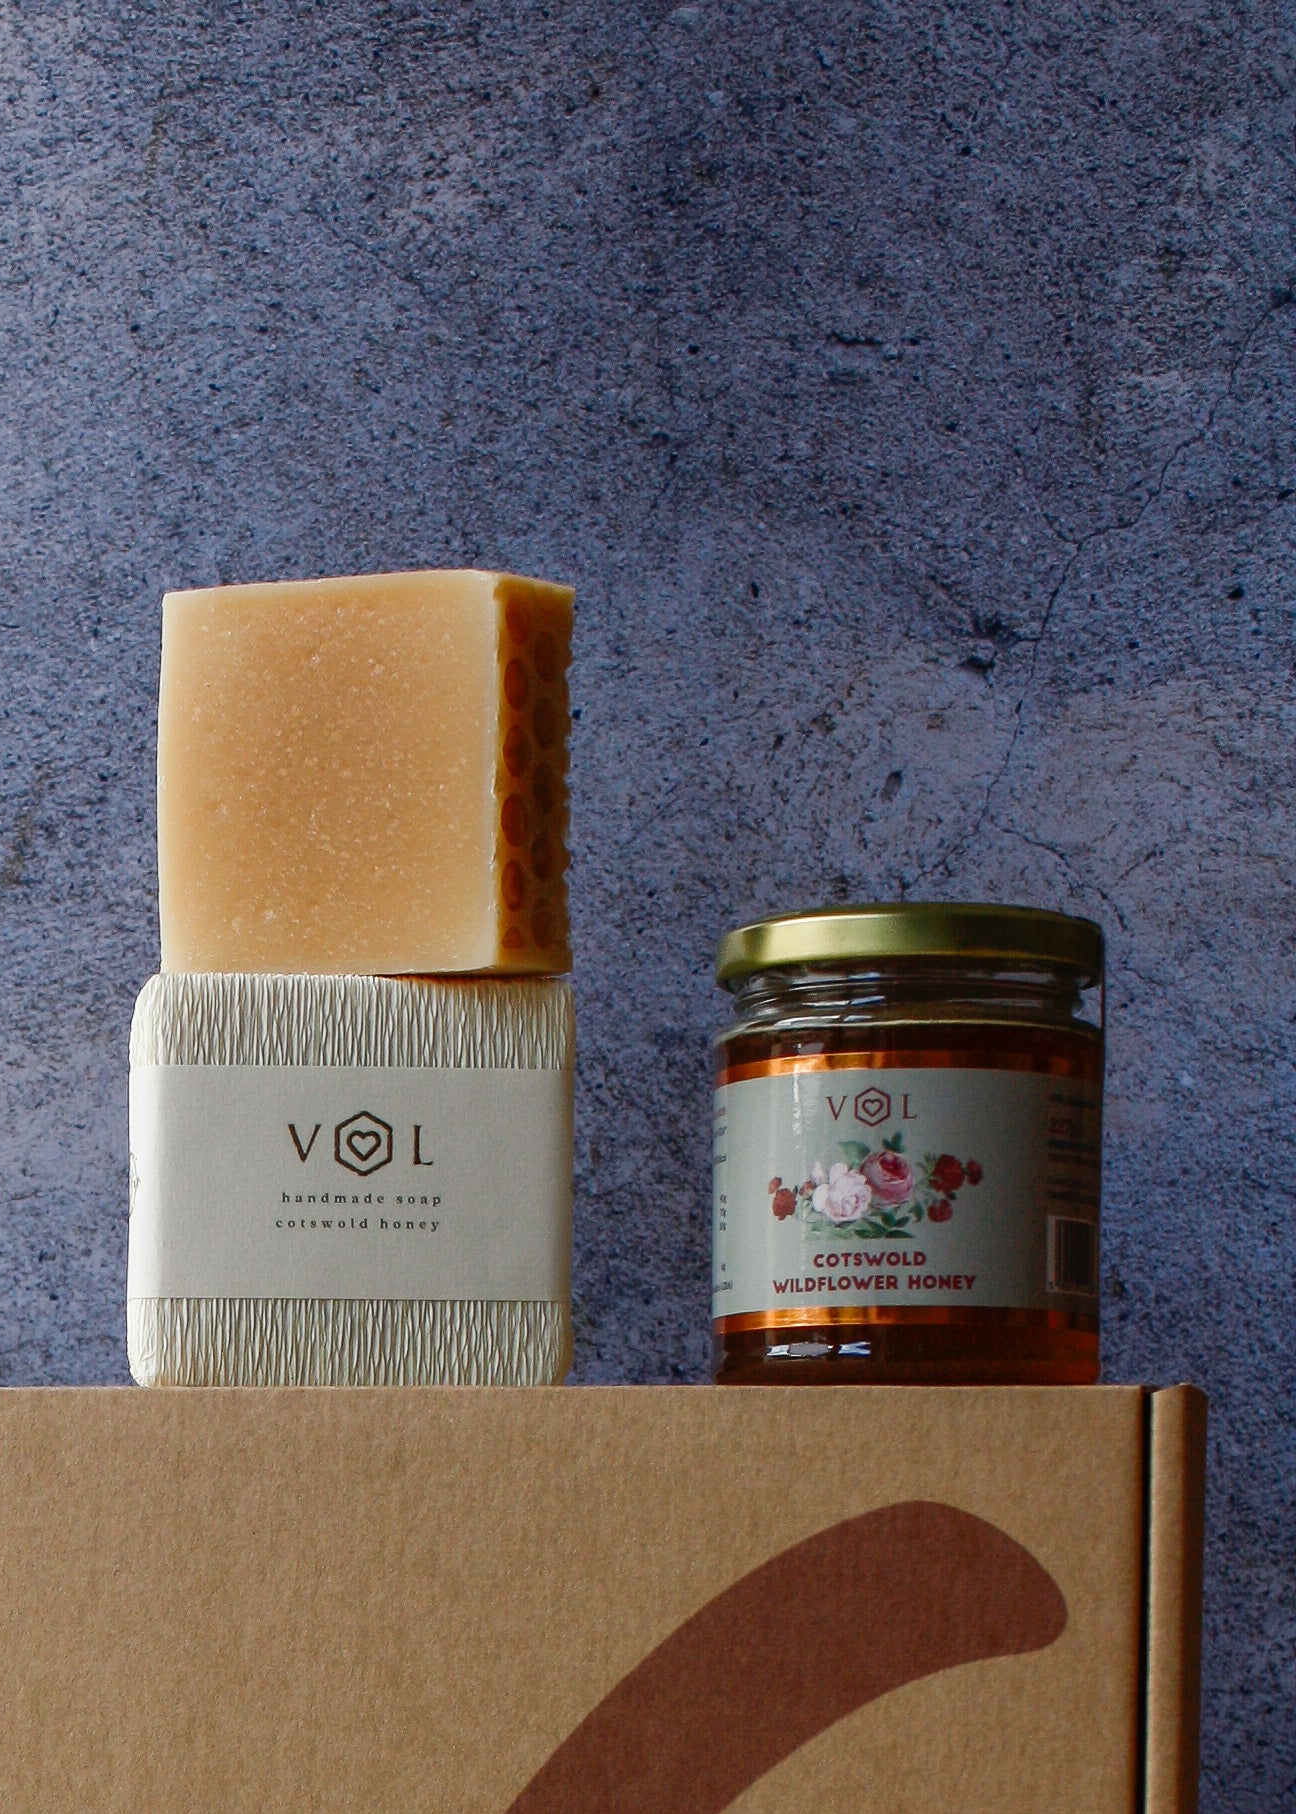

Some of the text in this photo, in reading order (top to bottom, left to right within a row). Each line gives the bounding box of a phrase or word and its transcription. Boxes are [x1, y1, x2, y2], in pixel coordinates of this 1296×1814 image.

[281, 1192, 442, 1208] handmade soap
[275, 1218, 440, 1232] cotswold honey
[812, 1251, 927, 1269] COTSWOLD
[772, 1274, 977, 1295] WILDFLOWER HONEY
